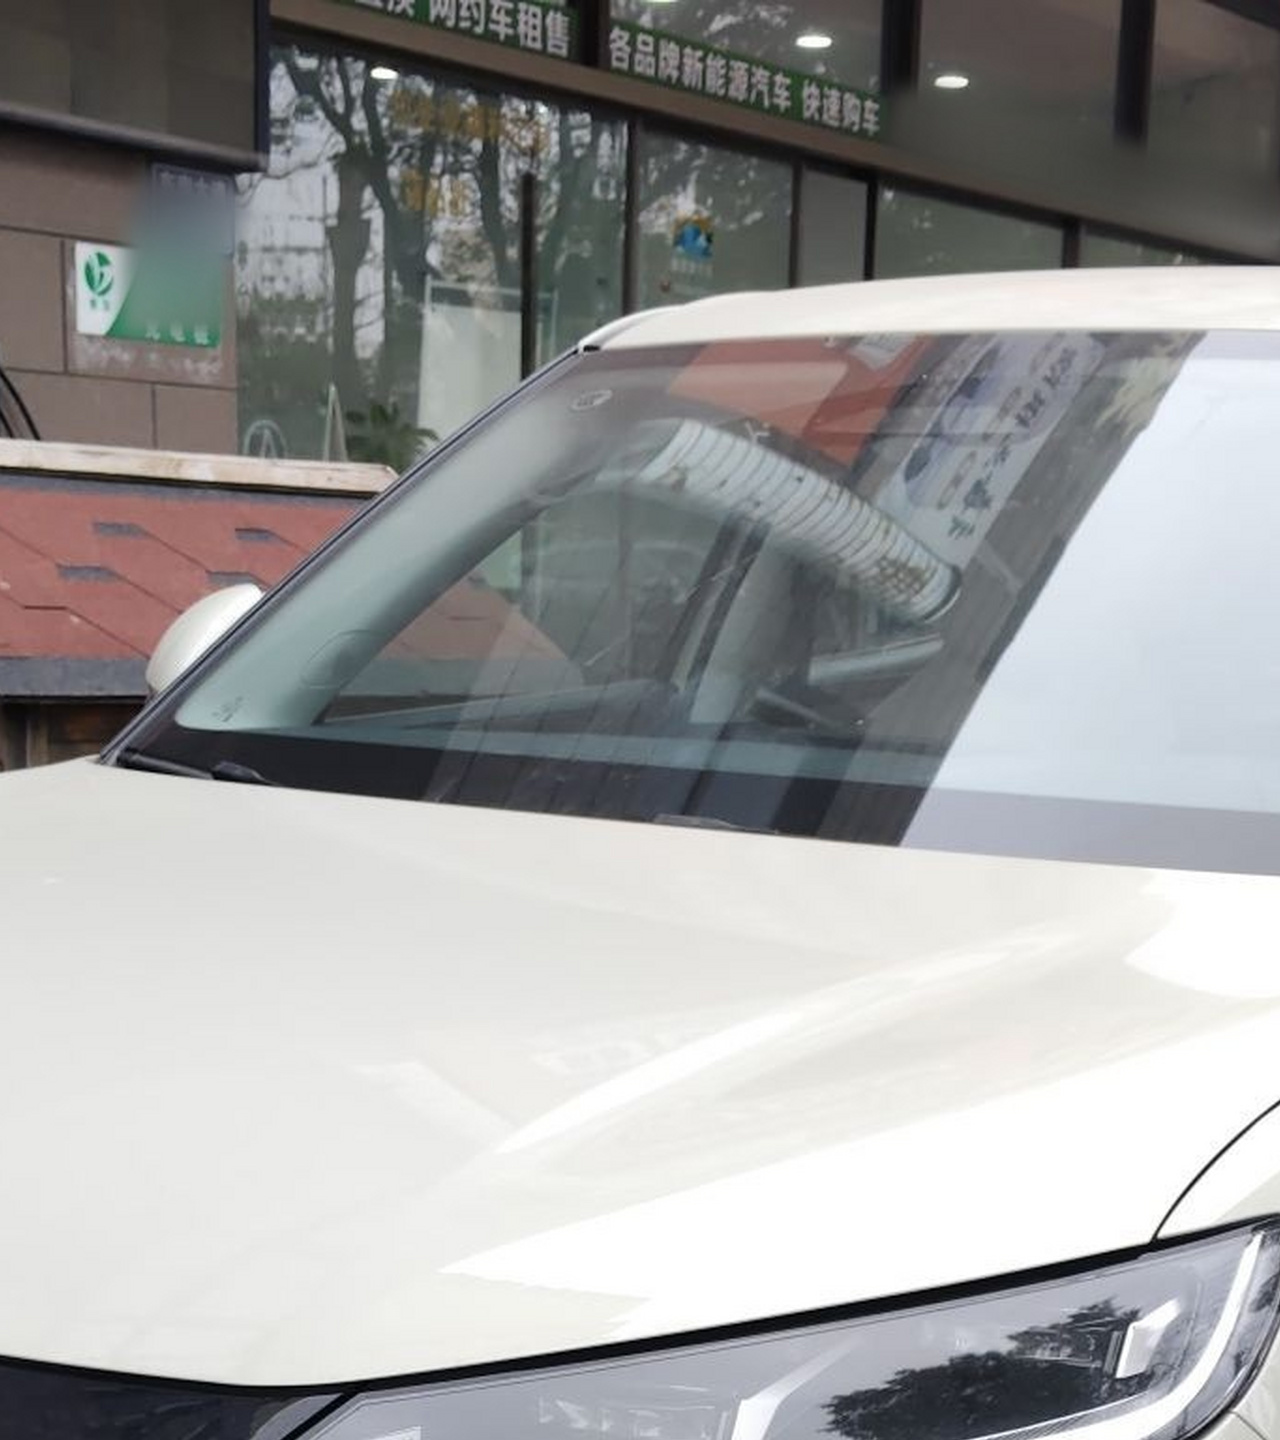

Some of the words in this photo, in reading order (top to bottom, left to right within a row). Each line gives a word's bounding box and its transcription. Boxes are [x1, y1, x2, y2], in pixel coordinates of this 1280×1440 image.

[609, 26, 791, 114] 各品牌新能源汽车
[802, 78, 880, 136] 快速购车
